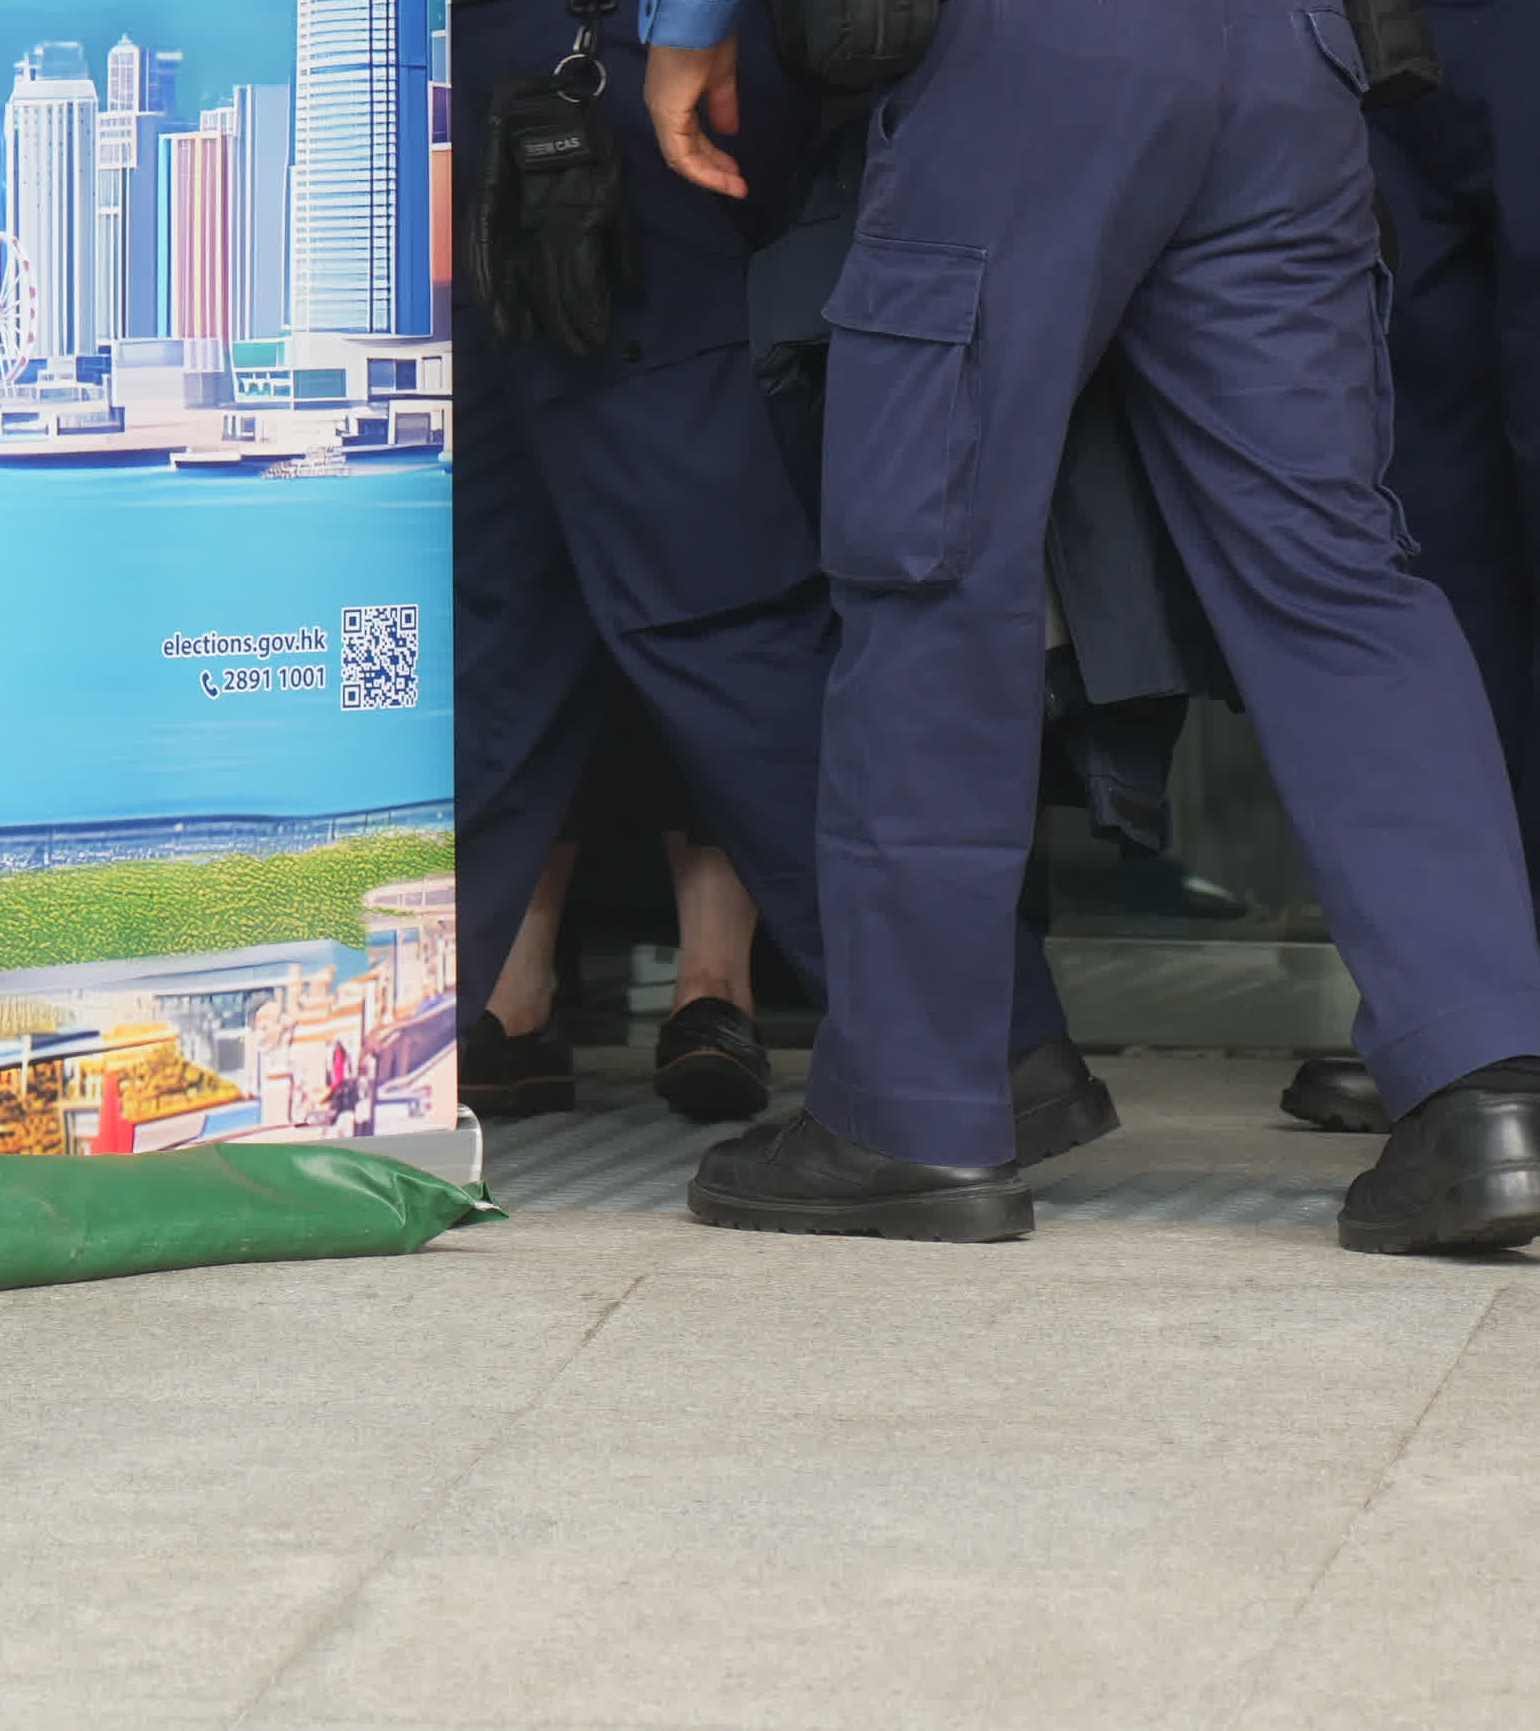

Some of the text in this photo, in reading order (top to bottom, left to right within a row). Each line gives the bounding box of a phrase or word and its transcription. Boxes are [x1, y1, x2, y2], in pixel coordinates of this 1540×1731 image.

[163, 627, 327, 658] elections.gov.hk
[223, 666, 326, 691] 2891 1001
